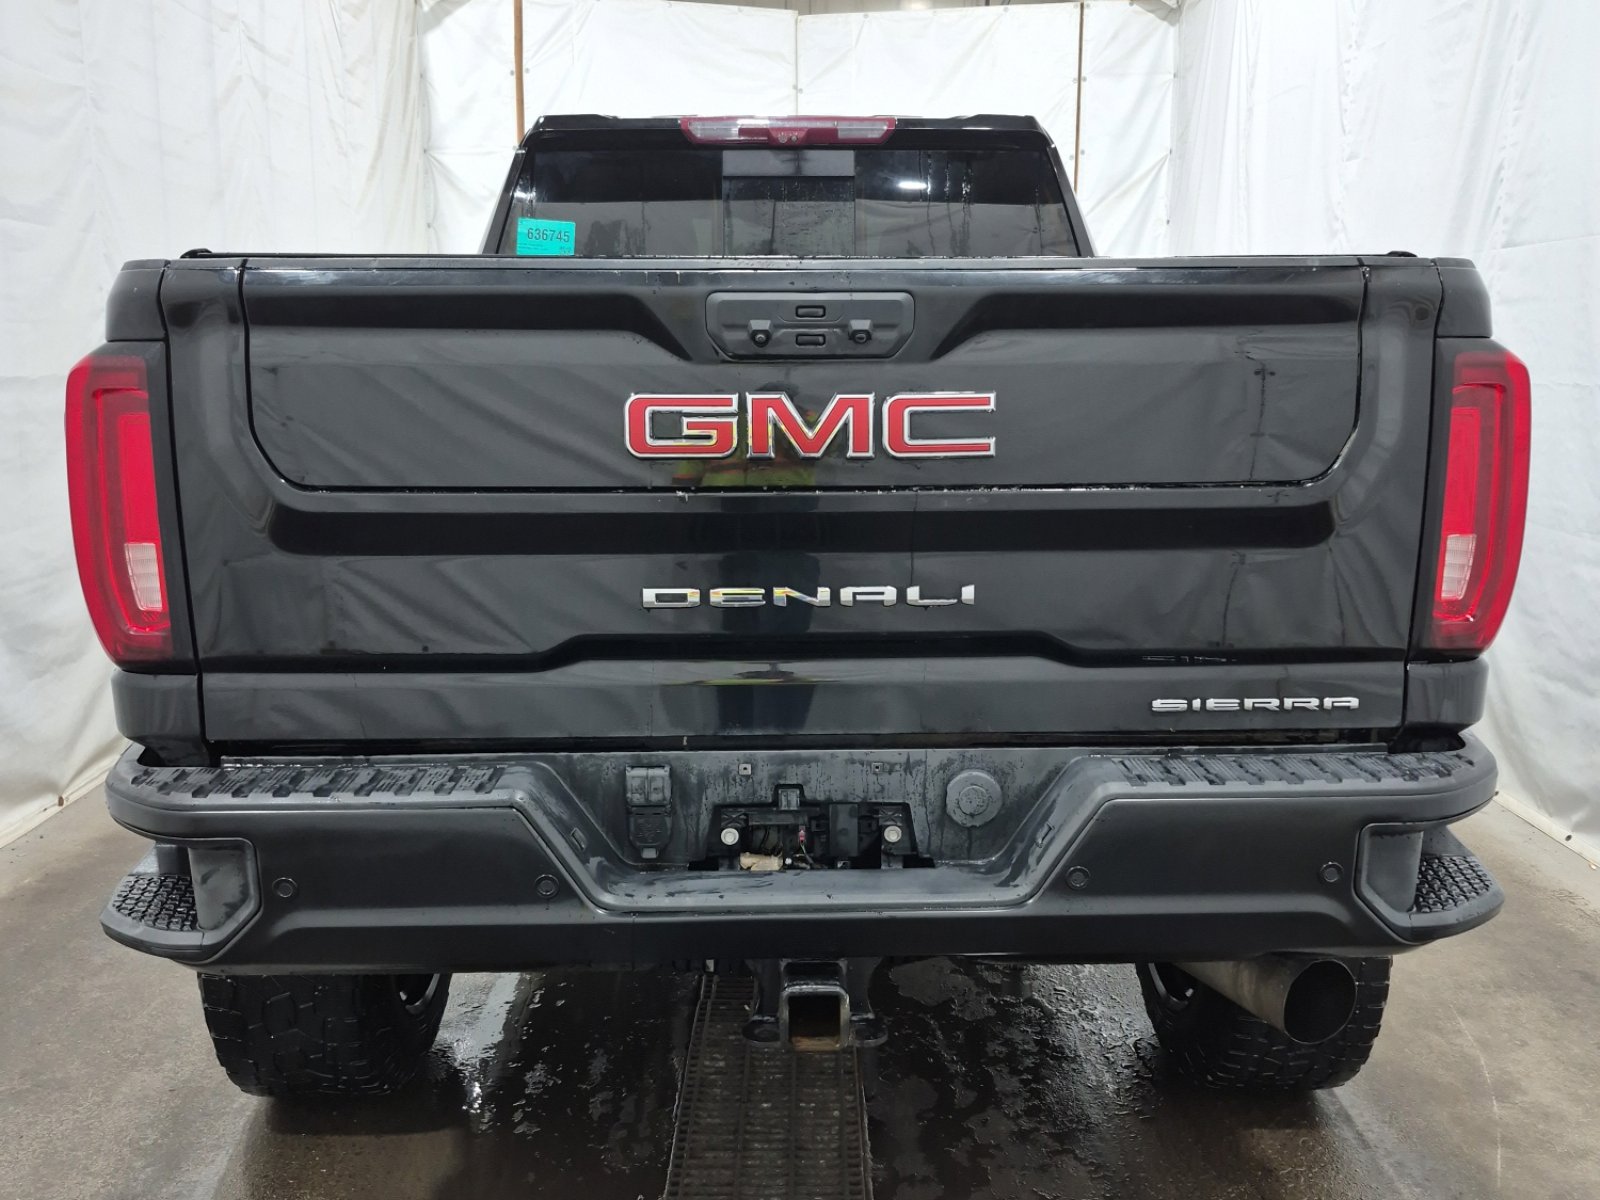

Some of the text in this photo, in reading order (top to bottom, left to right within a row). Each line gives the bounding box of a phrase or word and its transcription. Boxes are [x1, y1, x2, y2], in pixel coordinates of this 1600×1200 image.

[527, 227, 570, 243] 636745
[624, 392, 996, 459] GMC
[642, 584, 976, 608] DENALI
[1151, 696, 1360, 712] SIERRA
